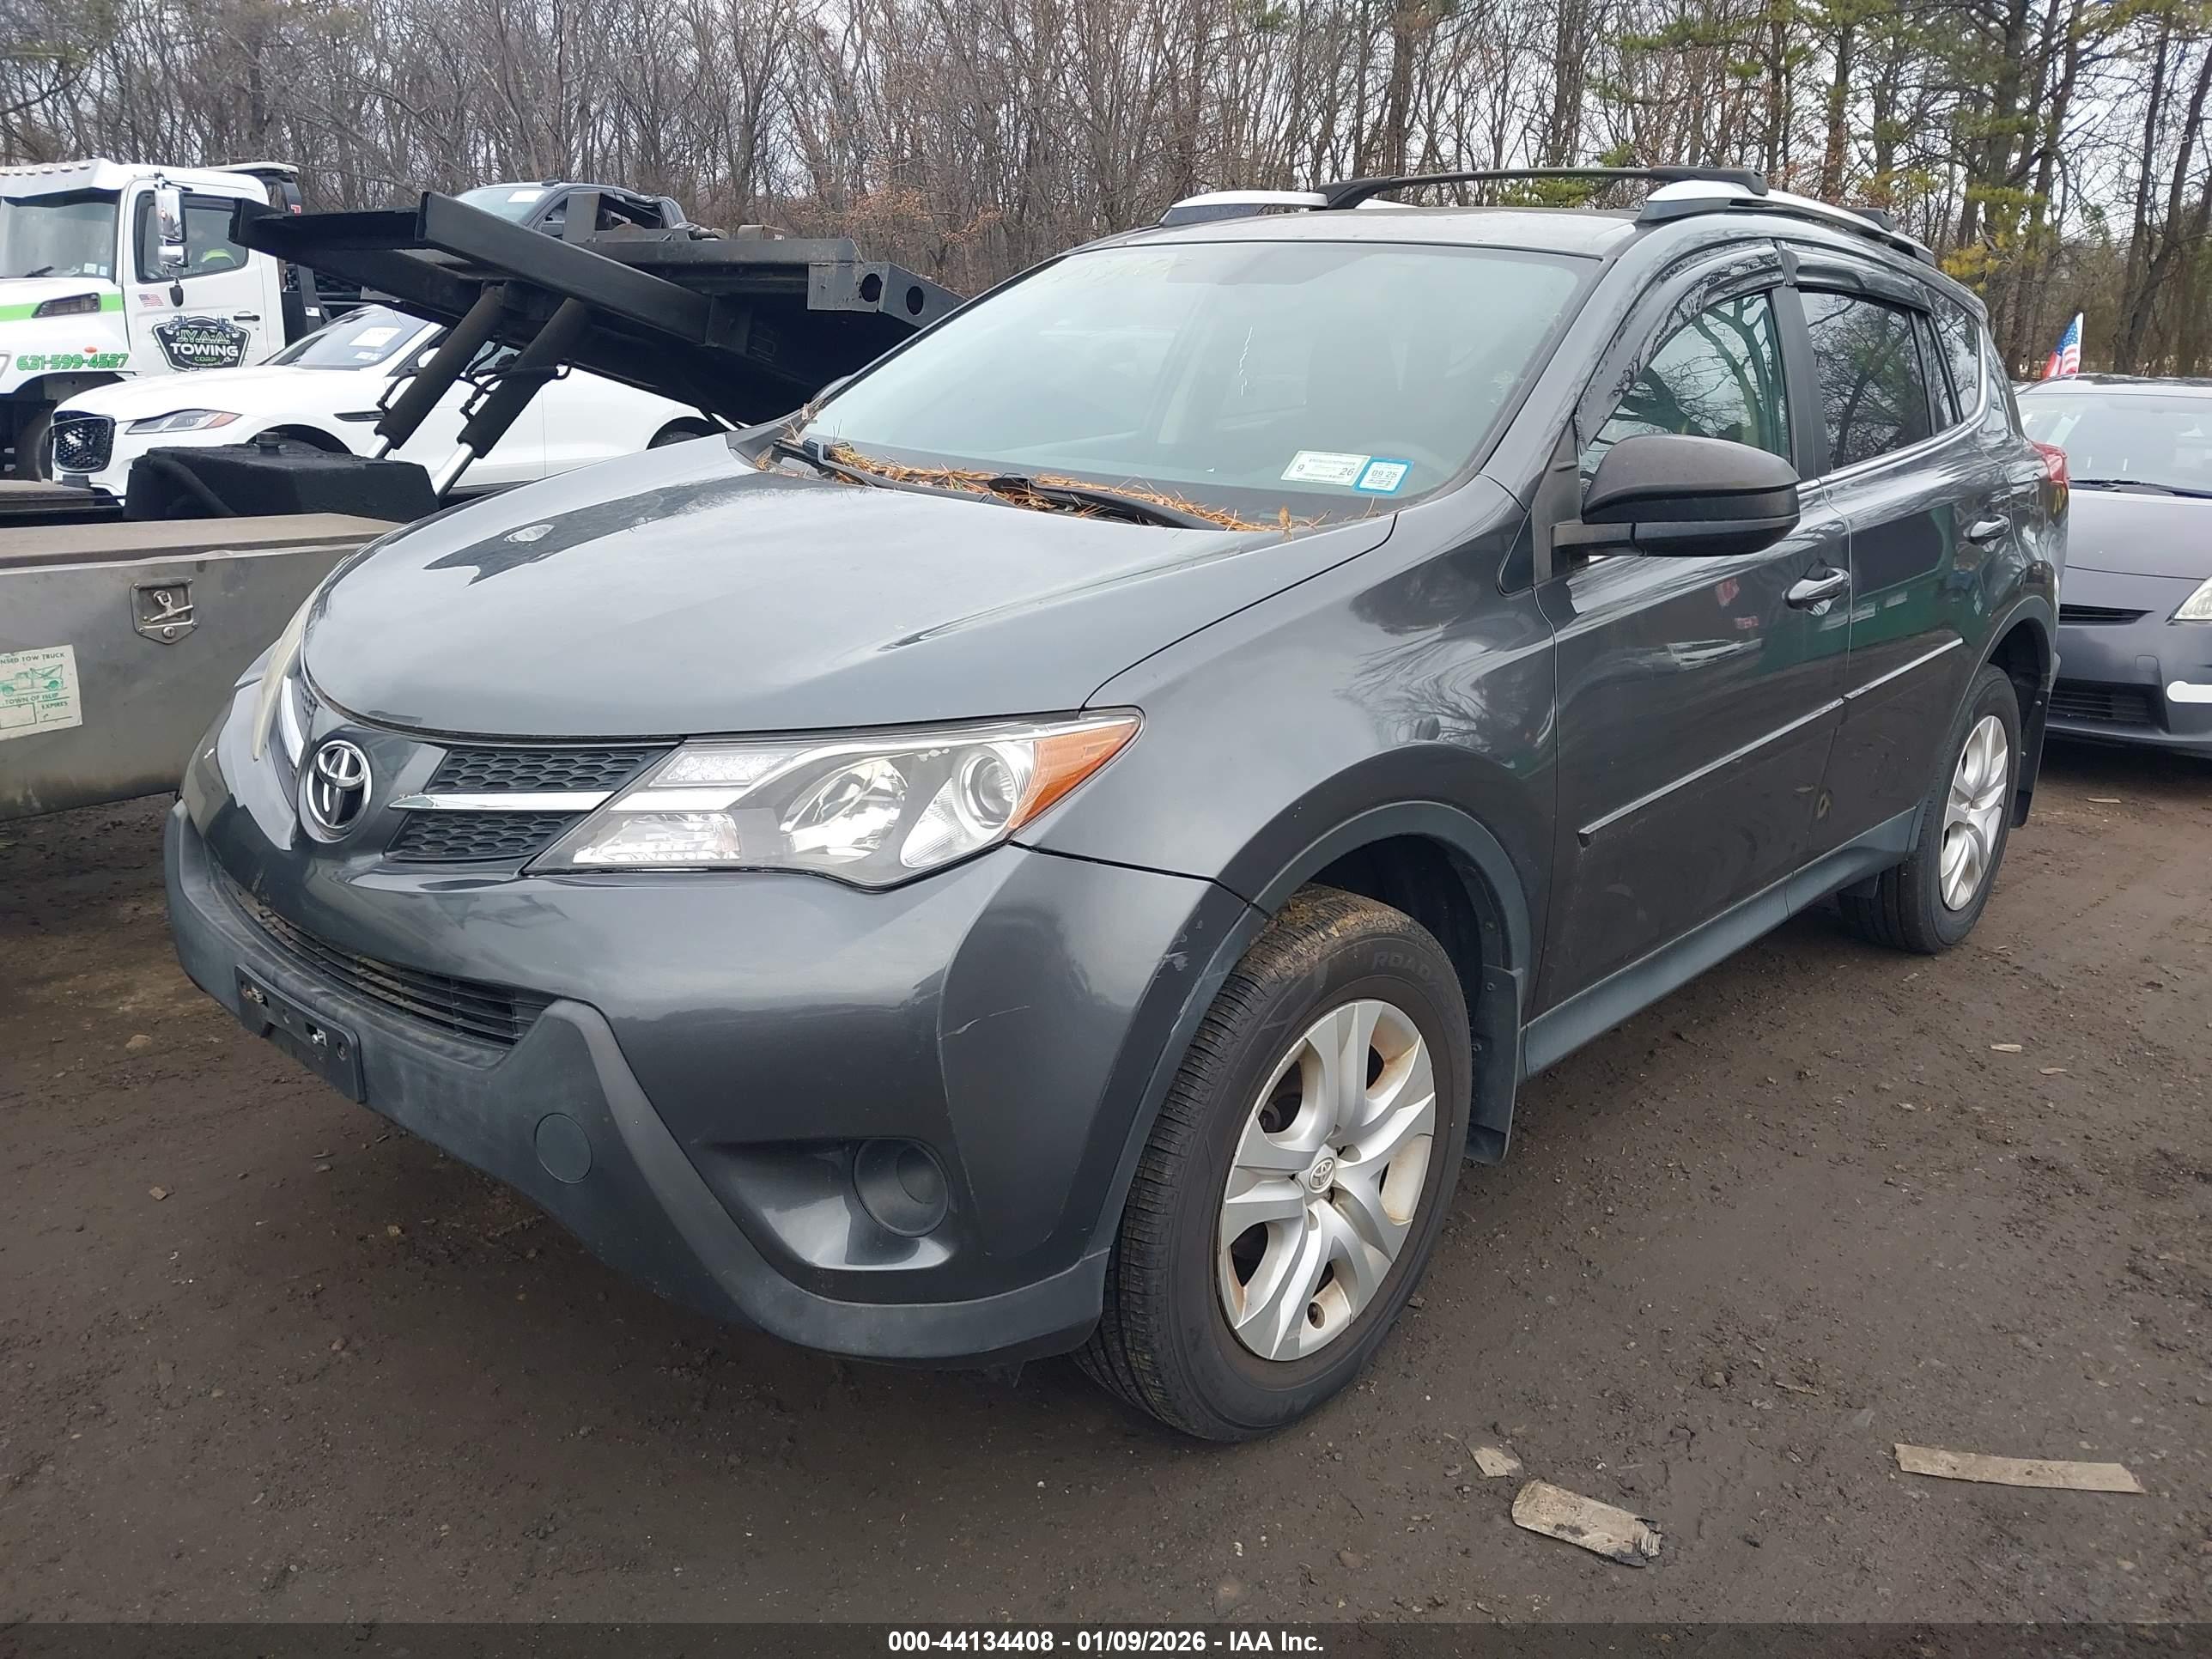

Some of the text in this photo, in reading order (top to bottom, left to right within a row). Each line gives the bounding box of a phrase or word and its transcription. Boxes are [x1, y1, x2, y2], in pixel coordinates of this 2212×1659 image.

[170, 343, 239, 357] TOWING
[16, 353, 129, 371] 631-599-4527
[1339, 467, 1355, 477] 26
